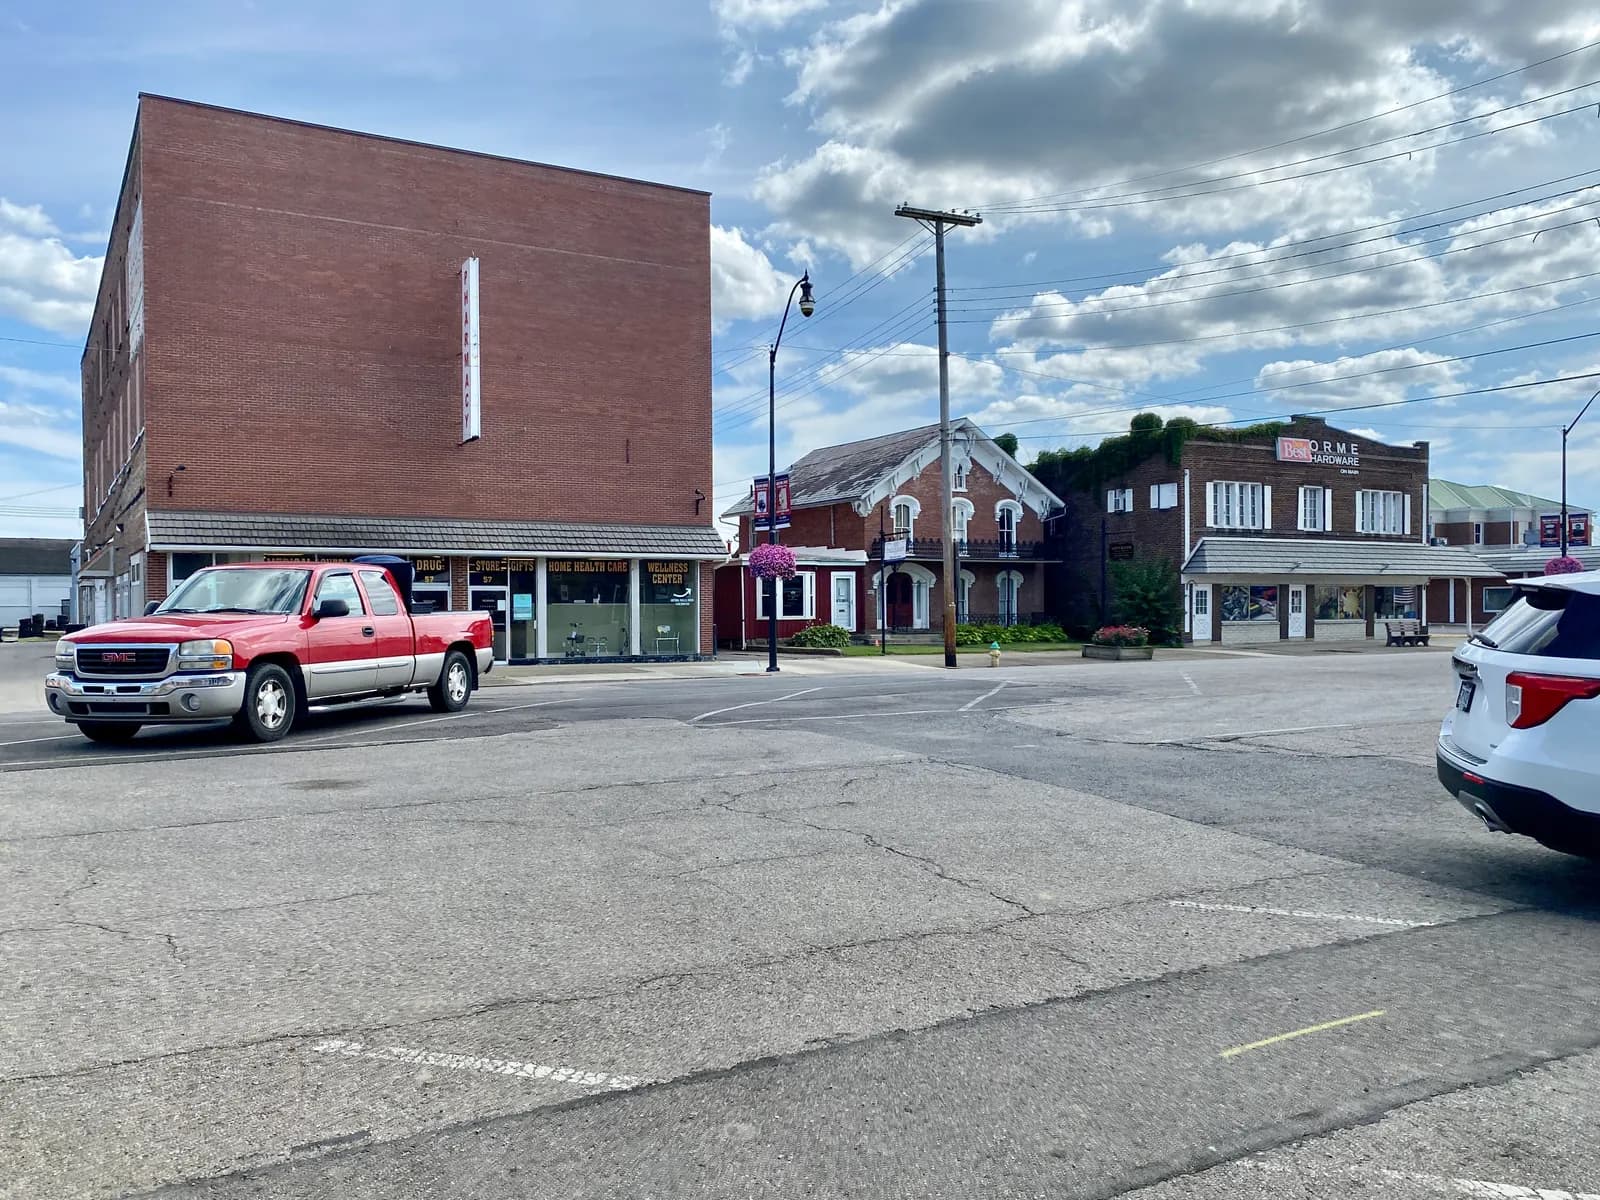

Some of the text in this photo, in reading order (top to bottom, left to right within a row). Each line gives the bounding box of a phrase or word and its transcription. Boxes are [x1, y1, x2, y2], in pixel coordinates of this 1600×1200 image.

[1284, 442, 1307, 458] Best
[1309, 440, 1359, 455] ORME
[1311, 454, 1360, 467] HARDWARE
[416, 559, 442, 571] DRUG
[475, 560, 500, 571] STORE
[510, 561, 534, 572] GIFTS
[548, 561, 628, 573] HOME HEALTH CARE
[647, 562, 689, 573] WELLNESS
[424, 575, 434, 583] 57
[652, 574, 683, 584] CENTER
[102, 652, 136, 663] GMC
